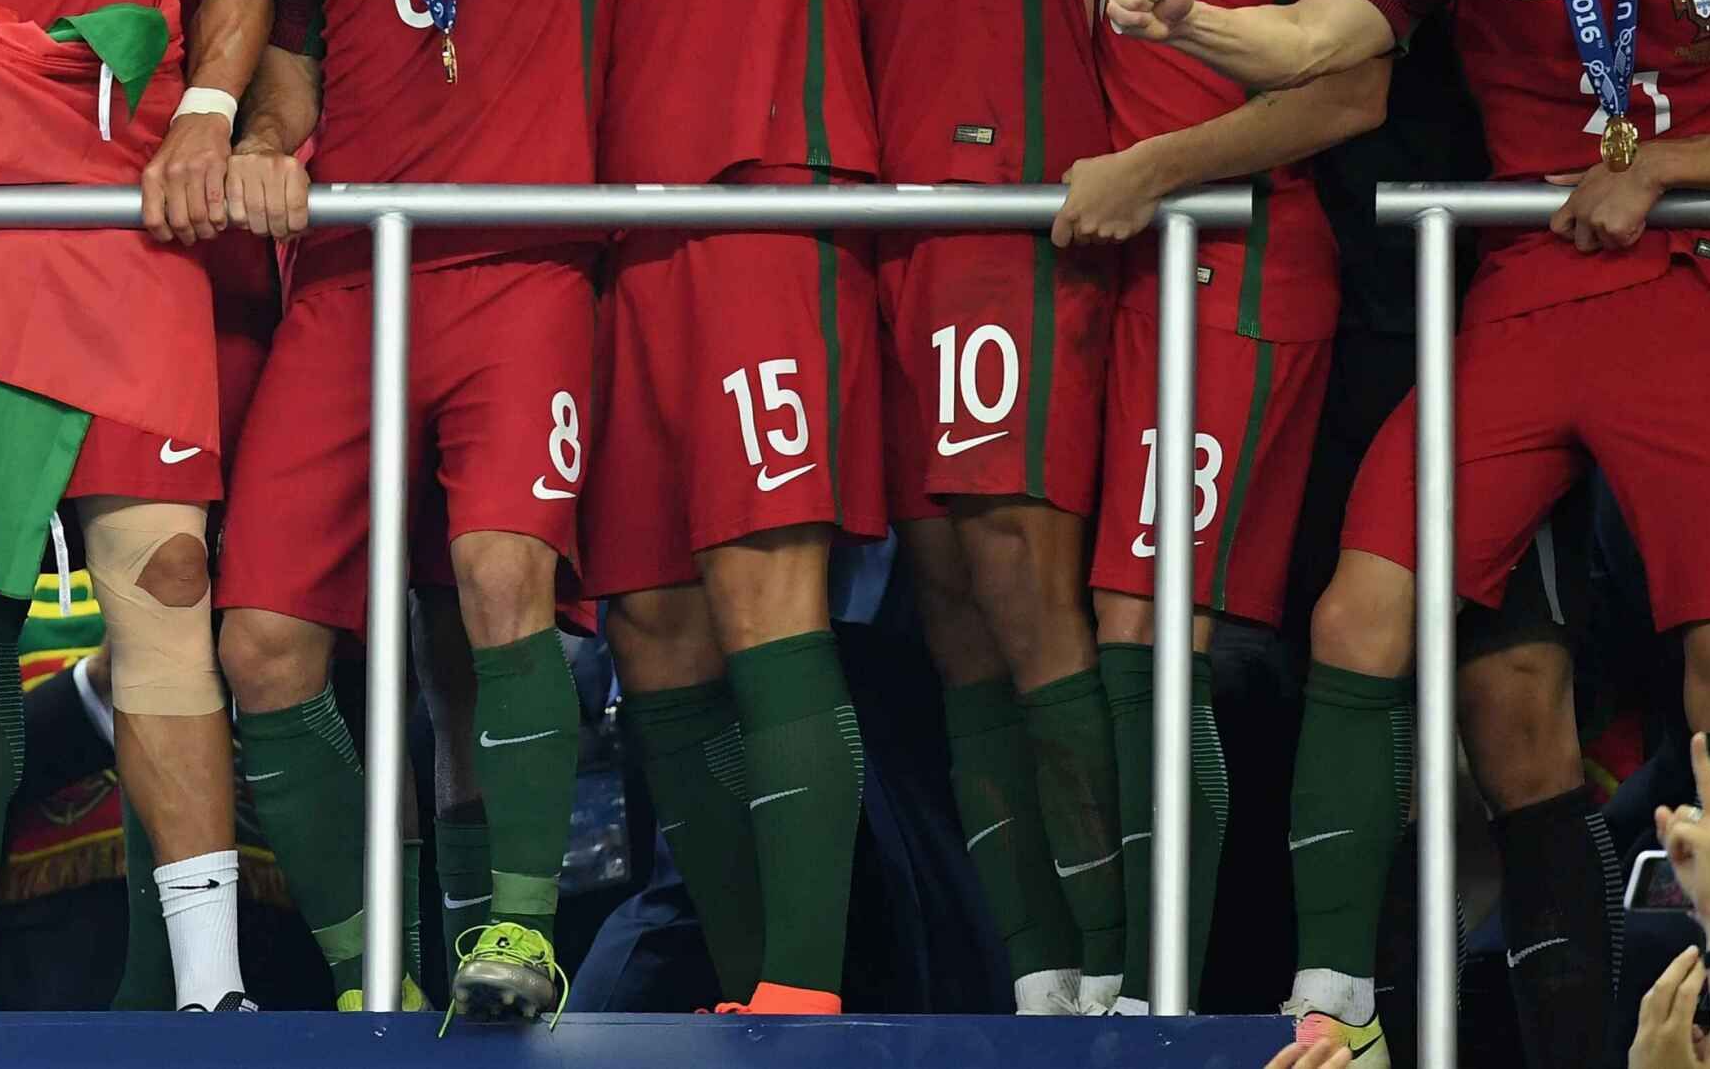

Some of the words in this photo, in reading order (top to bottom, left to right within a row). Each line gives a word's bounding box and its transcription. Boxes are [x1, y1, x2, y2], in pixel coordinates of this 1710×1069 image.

[722, 357, 810, 467] 15
[930, 323, 1020, 425] 10
[548, 390, 582, 485] 8
